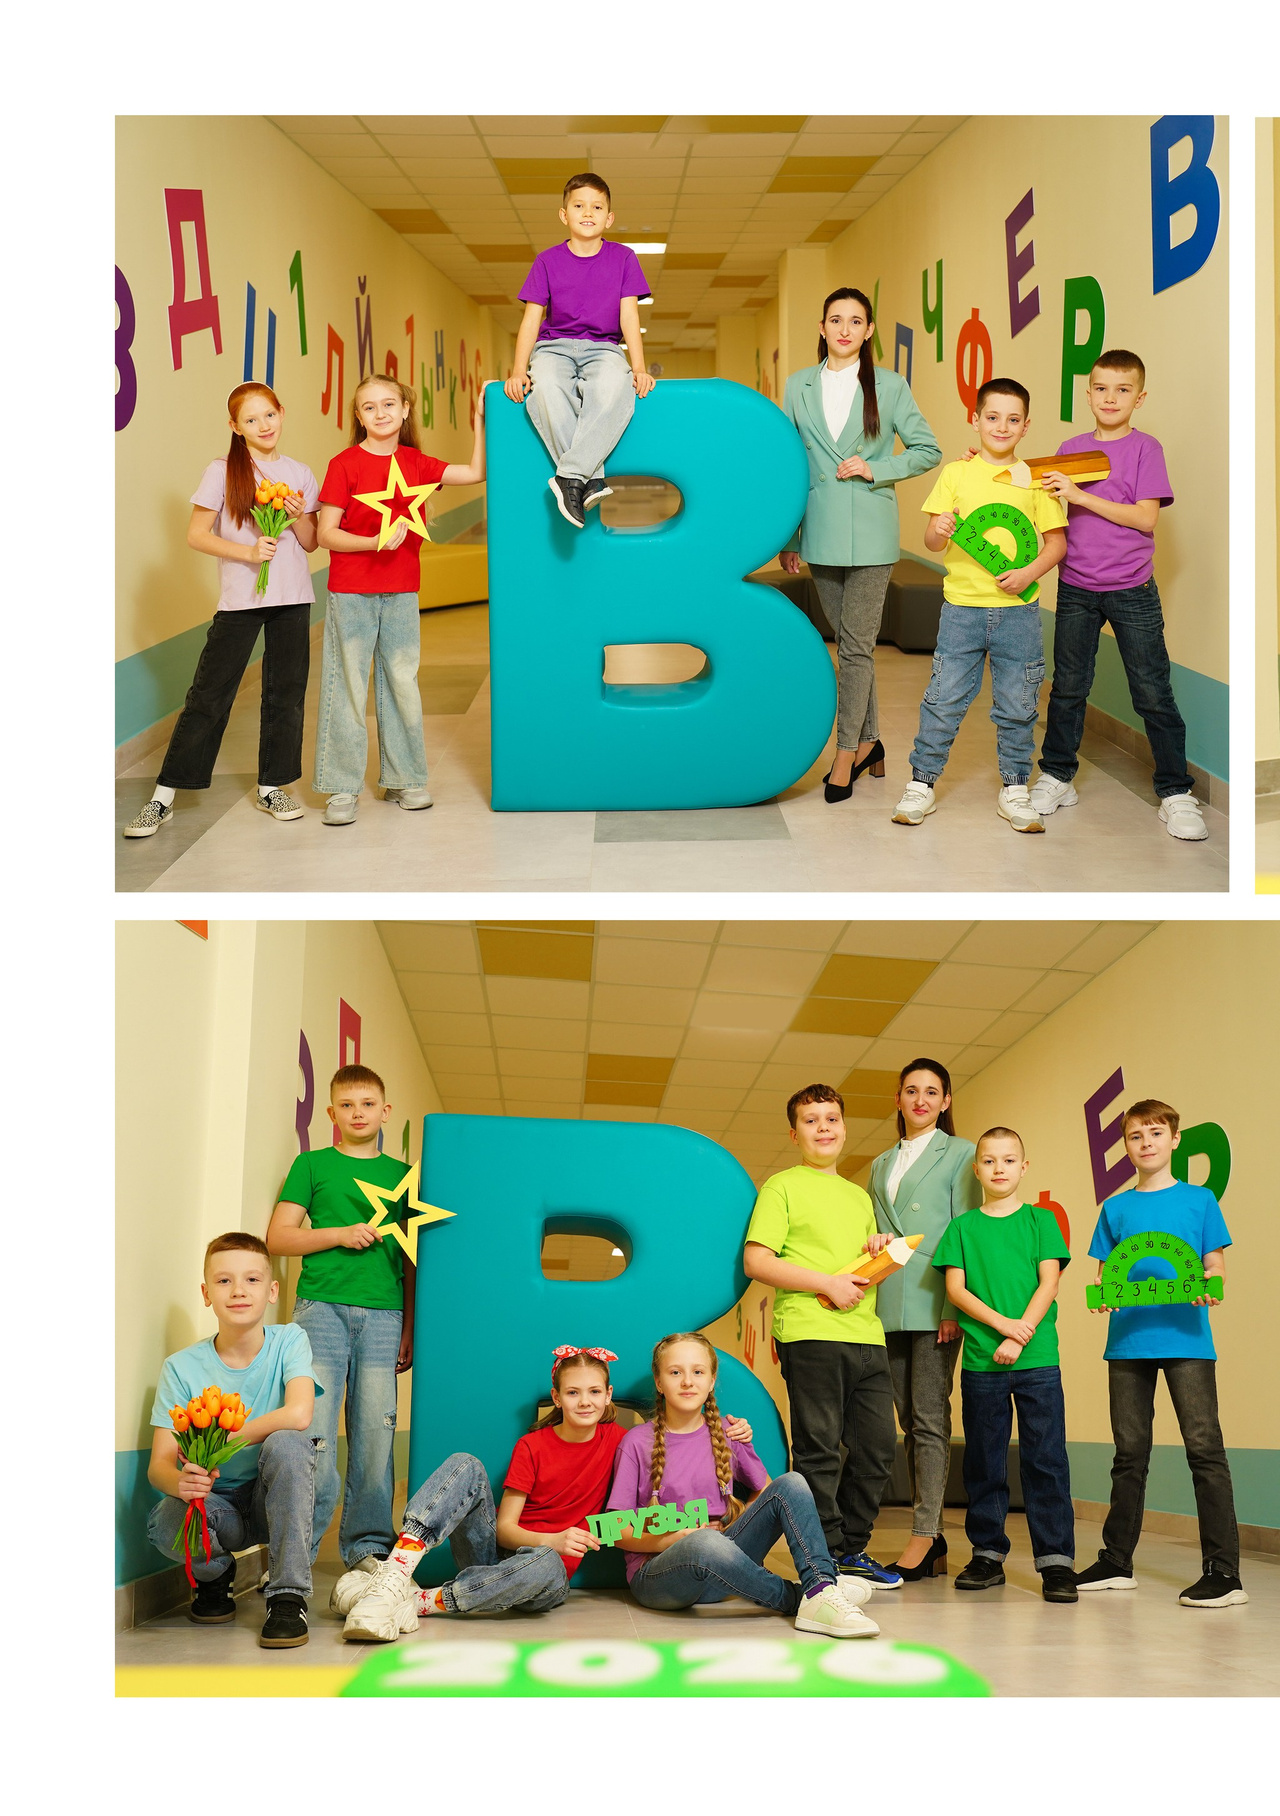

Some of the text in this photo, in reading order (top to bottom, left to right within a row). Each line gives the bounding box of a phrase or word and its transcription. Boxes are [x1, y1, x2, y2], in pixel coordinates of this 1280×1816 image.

[1150, 115, 1221, 296] В
[164, 188, 223, 371] Д
[1005, 187, 1041, 339] Е
[922, 258, 943, 363] Ч
[321, 322, 344, 431] Л
[955, 522, 1010, 570] 1 2 3 4 5
[1099, 1279, 1209, 1300] 1 2 3 4 5 6 7
[1111, 1264, 1120, 1273] 20
[1119, 1252, 1128, 1261] 40
[1130, 1243, 1140, 1252] 60
[1145, 1240, 1154, 1249] 90
[1160, 1241, 1171, 1250] 120
[585, 1498, 710, 1551] ДРУЗЬЯ
[378, 1637, 950, 1689] 2026
